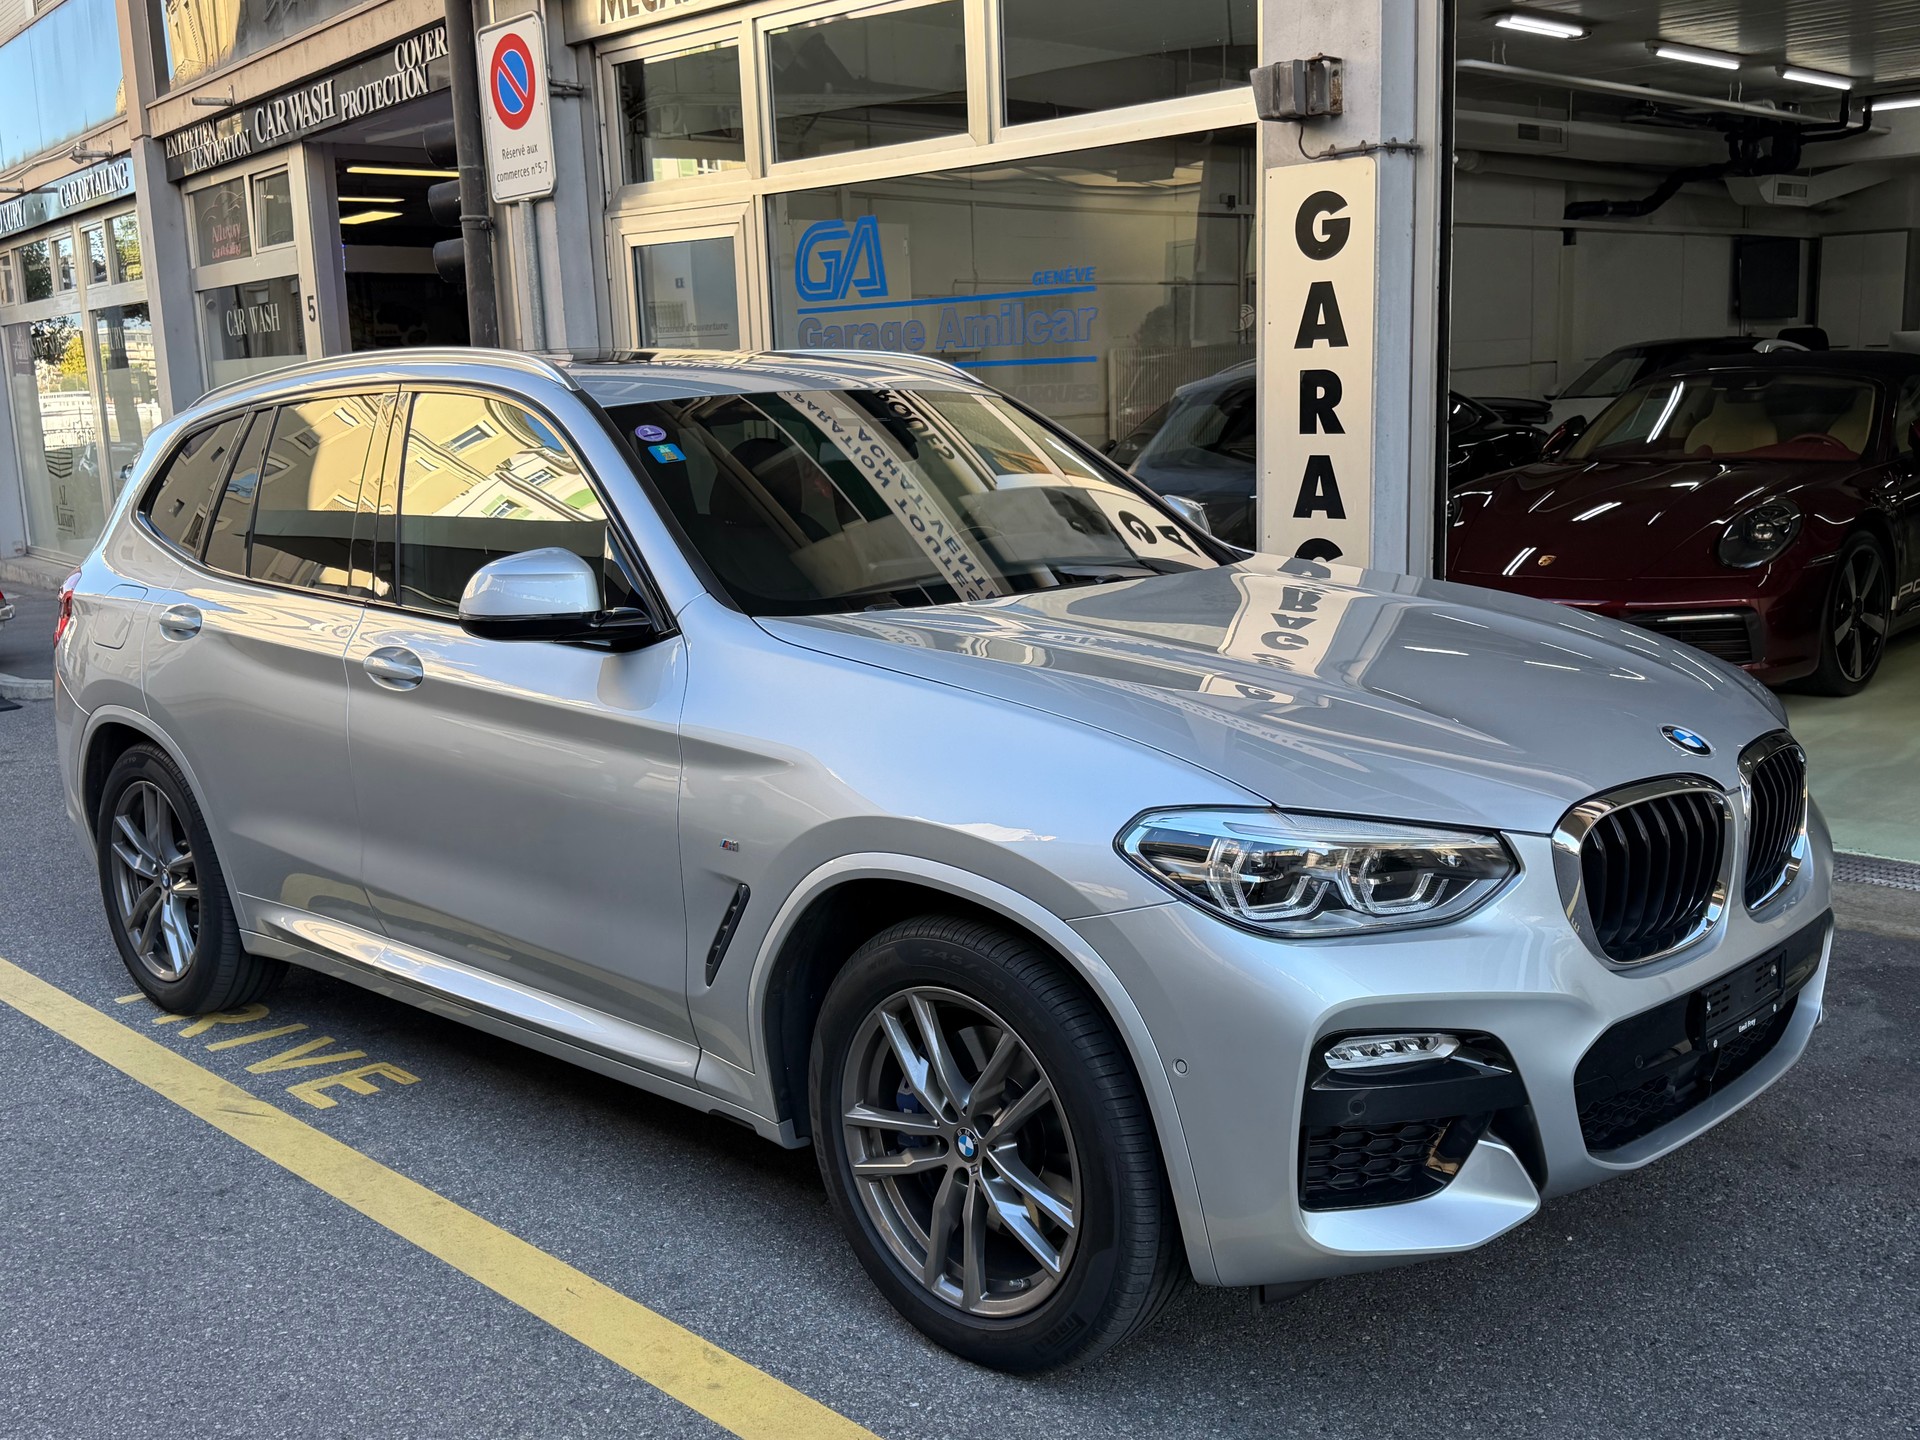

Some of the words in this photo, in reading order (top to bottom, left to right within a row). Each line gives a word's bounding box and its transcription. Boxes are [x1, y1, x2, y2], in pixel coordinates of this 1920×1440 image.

[394, 25, 449, 72] COVER
[254, 99, 290, 144] CAR
[287, 79, 337, 129] WASH
[340, 63, 428, 121] PROTECTION
[166, 119, 217, 159] ENTRETIEN
[191, 129, 251, 172] RENOVATION
[501, 145, 525, 160] Réservé
[527, 144, 538, 155] aux
[497, 167, 530, 183] commerces
[795, 214, 888, 302] GA
[226, 308, 247, 337] CAR
[248, 303, 281, 333] WASH
[307, 295, 316, 322] 5
[797, 316, 925, 350] Garage
[936, 303, 1097, 350] Amilcar
